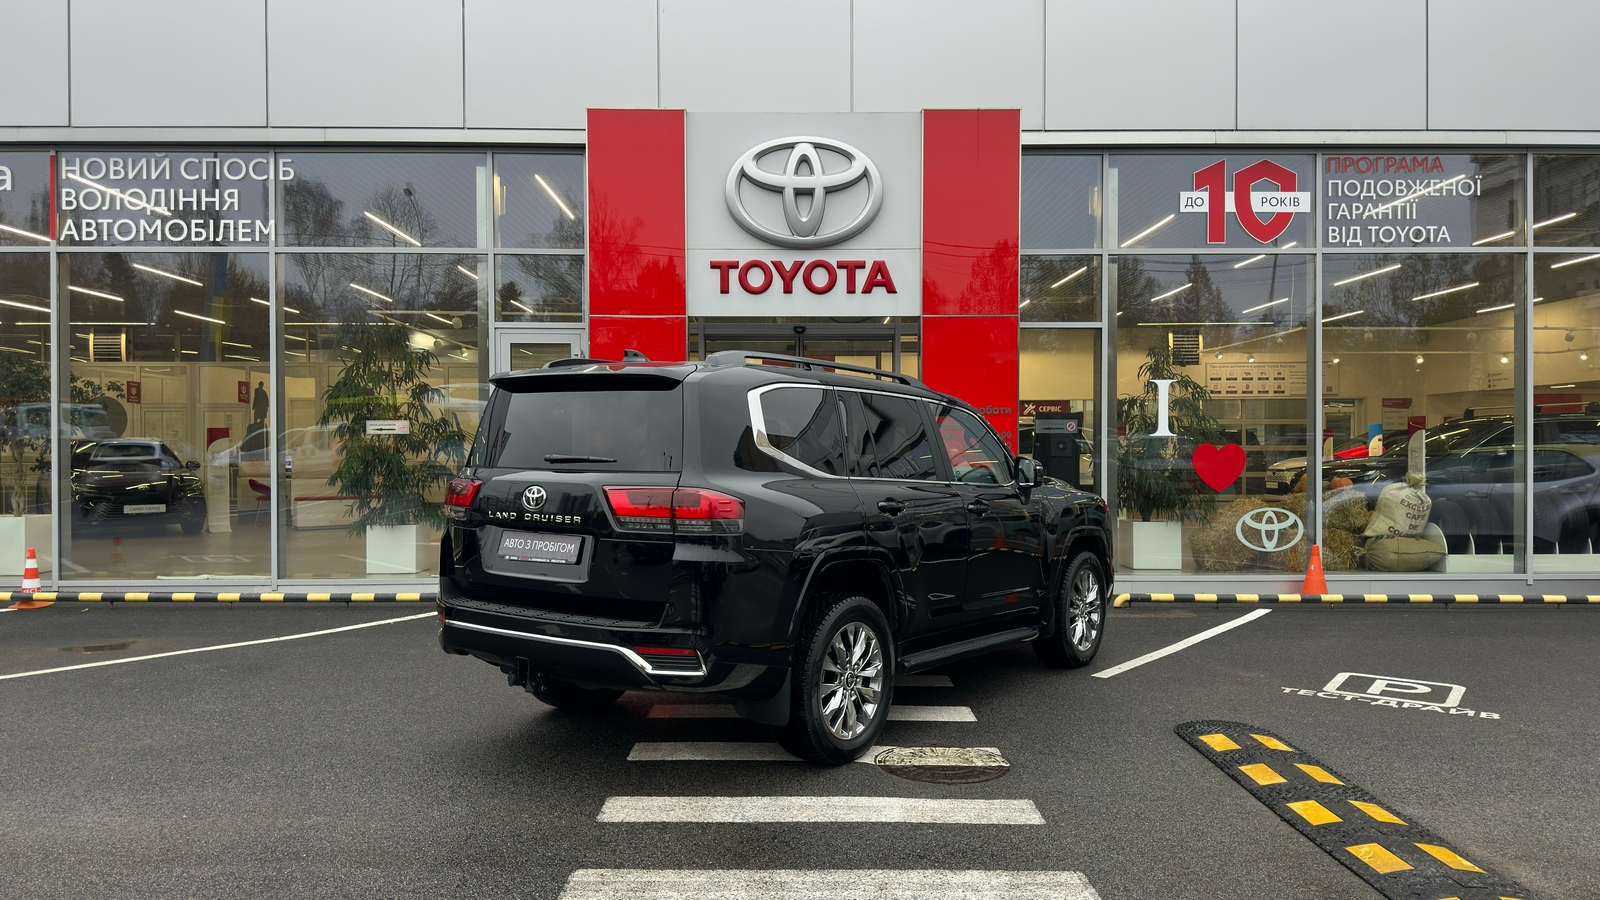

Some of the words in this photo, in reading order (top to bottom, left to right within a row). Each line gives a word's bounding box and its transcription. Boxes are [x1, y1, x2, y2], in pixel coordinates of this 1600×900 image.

[61, 152, 171, 180] НОВИЙ
[180, 157, 295, 181] СПОСІБ
[1326, 155, 1445, 173] ПРОГРАМА
[1328, 175, 1482, 200] ПОДОВЖЕНОЇ
[61, 188, 239, 215] ВОЛОДІННЯ
[1184, 197, 1204, 209] ДО
[1193, 158, 1298, 244] 10
[1260, 196, 1300, 208] РОКІВ
[1328, 199, 1418, 220] ГАРАНТІЇ
[60, 218, 275, 242] АВТОМОБІЛЕМ
[1328, 226, 1362, 246] ВІД
[1367, 226, 1451, 243] TOYOTA
[710, 259, 898, 295] TOYOTA
[1149, 379, 1177, 437] I
[488, 511, 517, 519] LAND
[524, 513, 581, 524] CRUISER
[503, 538, 525, 549] АВТО
[525, 540, 531, 549] З
[532, 540, 575, 553] ПРОБІГОМ
[1281, 686, 1501, 720] ТЕСТ-ДРАЙВ
